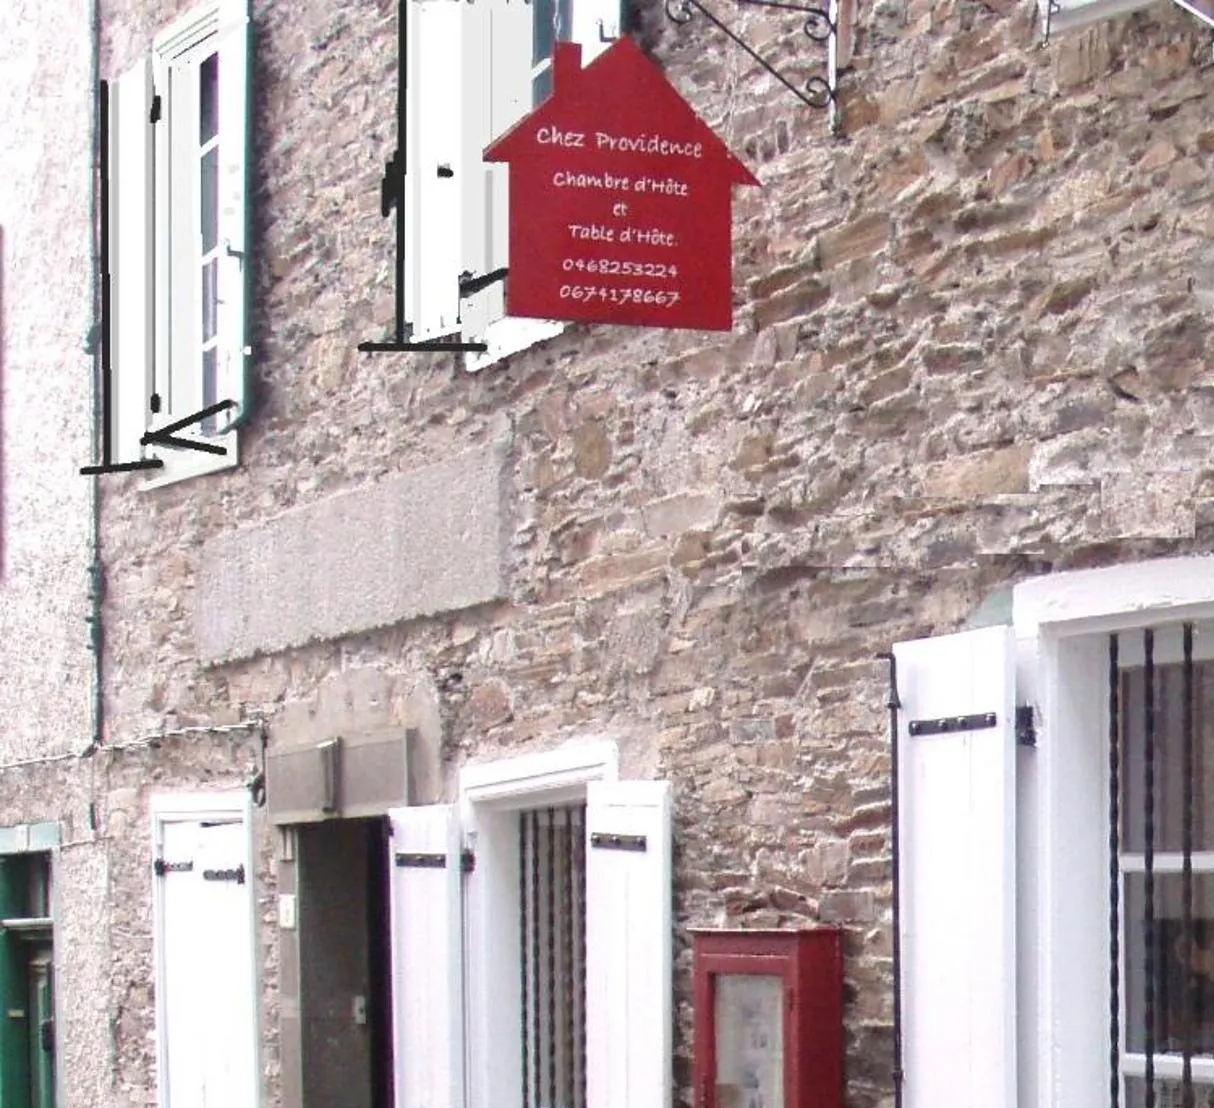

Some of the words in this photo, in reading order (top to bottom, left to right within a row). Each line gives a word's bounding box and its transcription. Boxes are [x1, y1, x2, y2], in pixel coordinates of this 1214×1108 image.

[536, 126, 586, 147] Chez
[596, 132, 704, 158] Providence
[553, 171, 630, 190] Chambre
[634, 177, 689, 195] d'Hôte
[612, 203, 628, 216] et
[568, 225, 614, 241] Table
[562, 258, 678, 278] 0468253224
[560, 285, 680, 307] 0674178667
